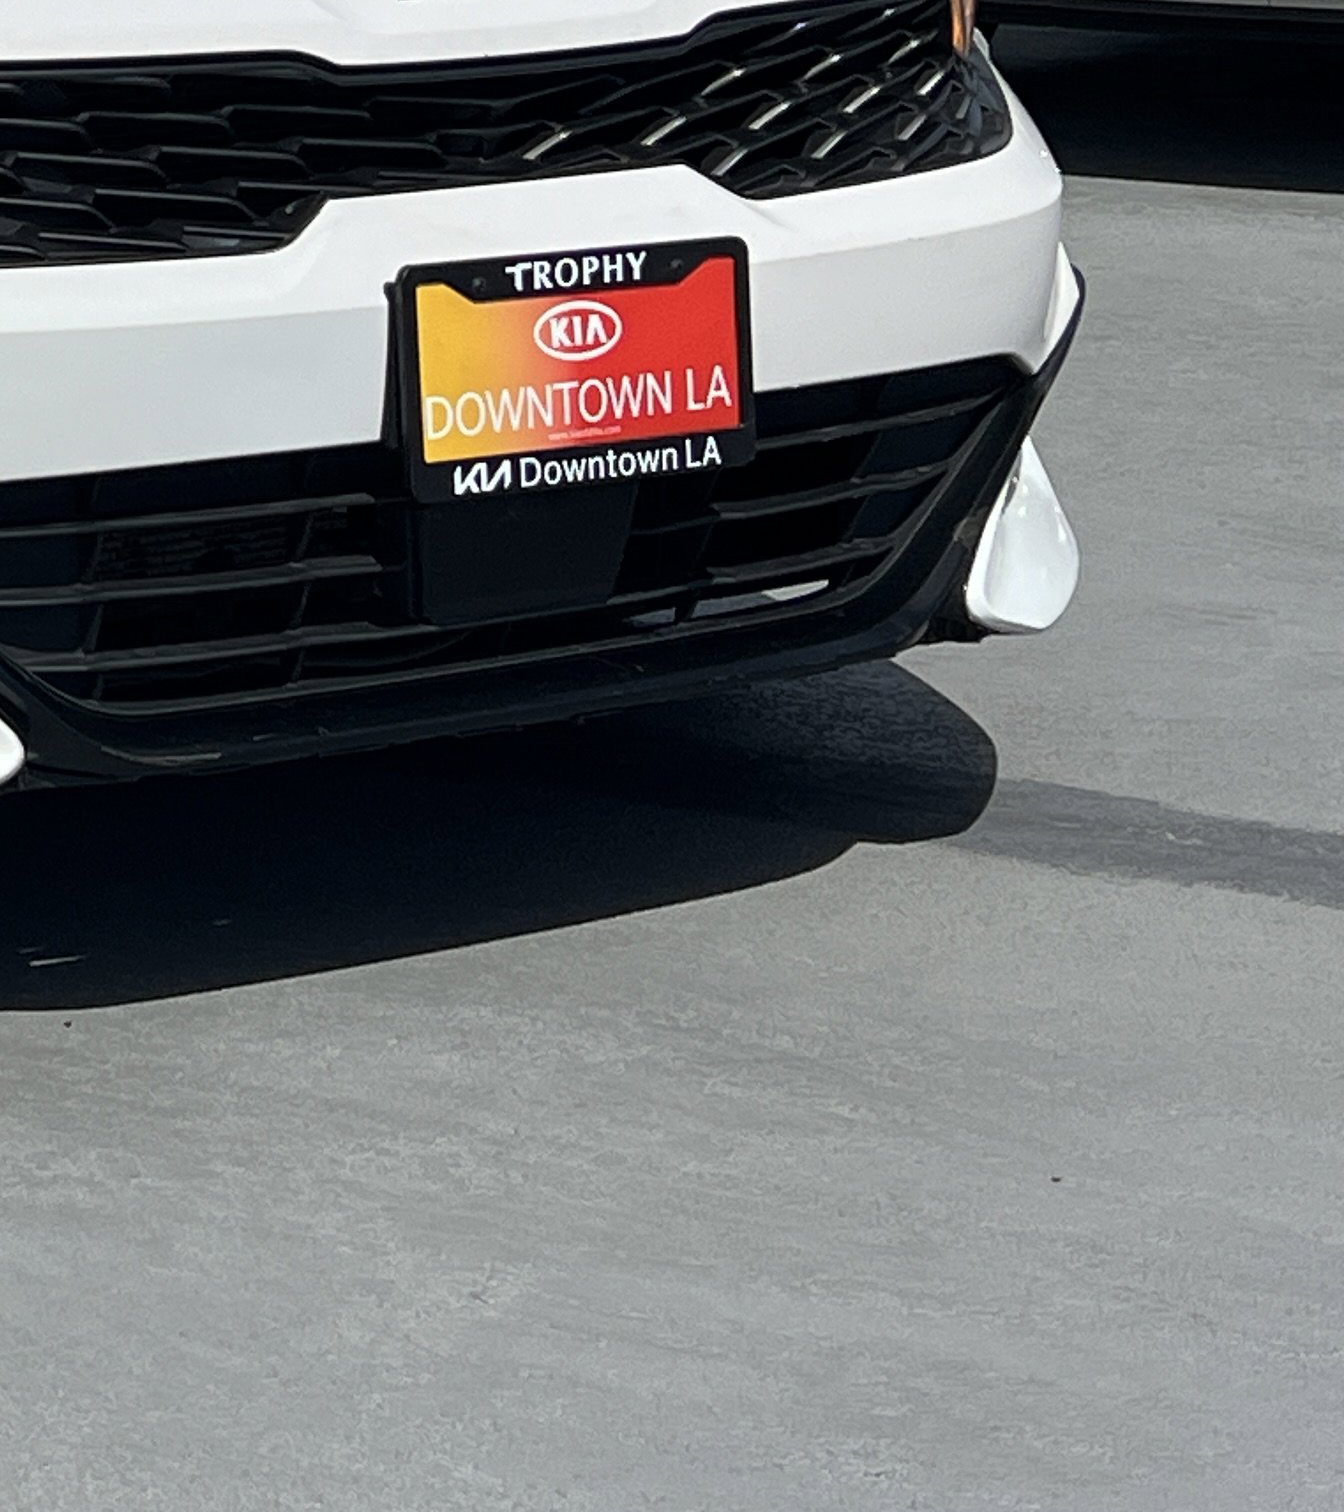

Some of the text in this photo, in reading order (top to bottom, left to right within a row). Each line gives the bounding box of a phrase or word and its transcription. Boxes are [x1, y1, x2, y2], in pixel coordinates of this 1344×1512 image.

[505, 251, 647, 292] TROPHY
[549, 314, 607, 349] KIA
[426, 364, 733, 441] DOWNTOWN LA
[519, 446, 679, 489] Downtown
[685, 435, 722, 469] LA
